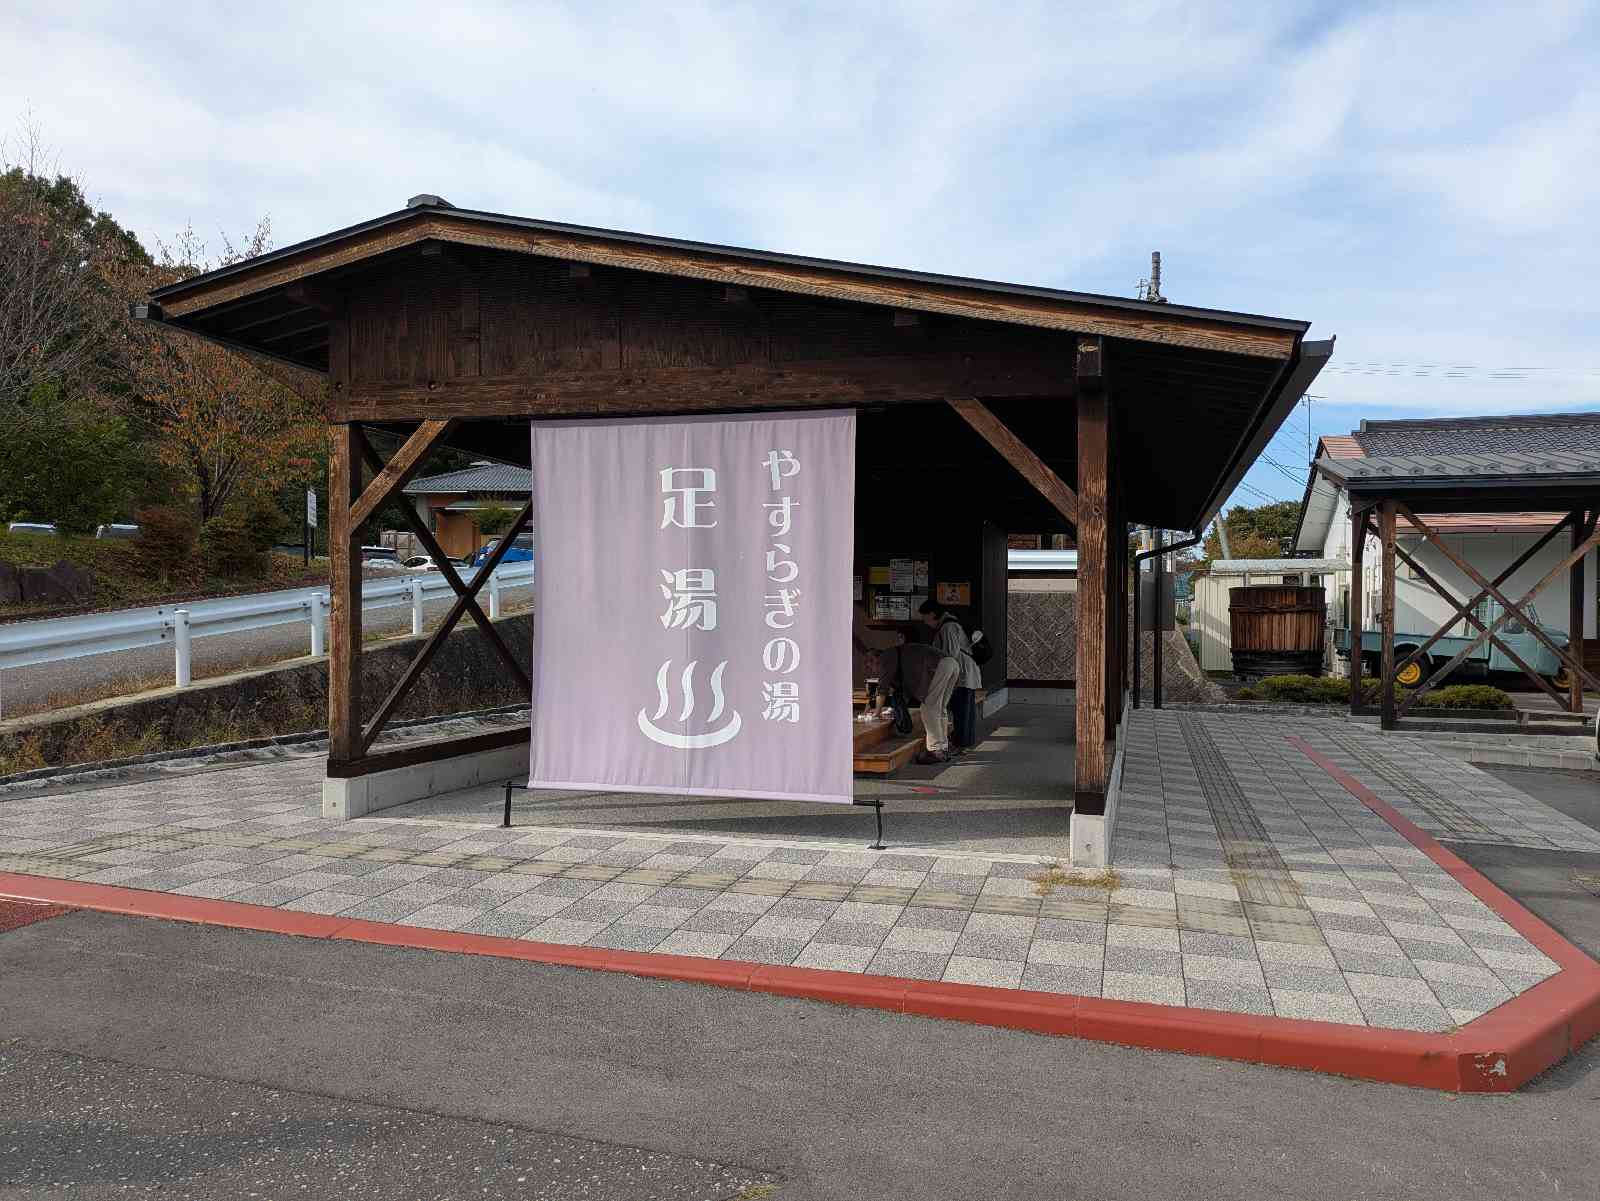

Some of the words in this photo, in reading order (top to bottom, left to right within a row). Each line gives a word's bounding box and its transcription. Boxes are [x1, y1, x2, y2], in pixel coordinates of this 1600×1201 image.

[660, 467, 719, 631] 足湯
[762, 449, 801, 723] やすらぎの湯
